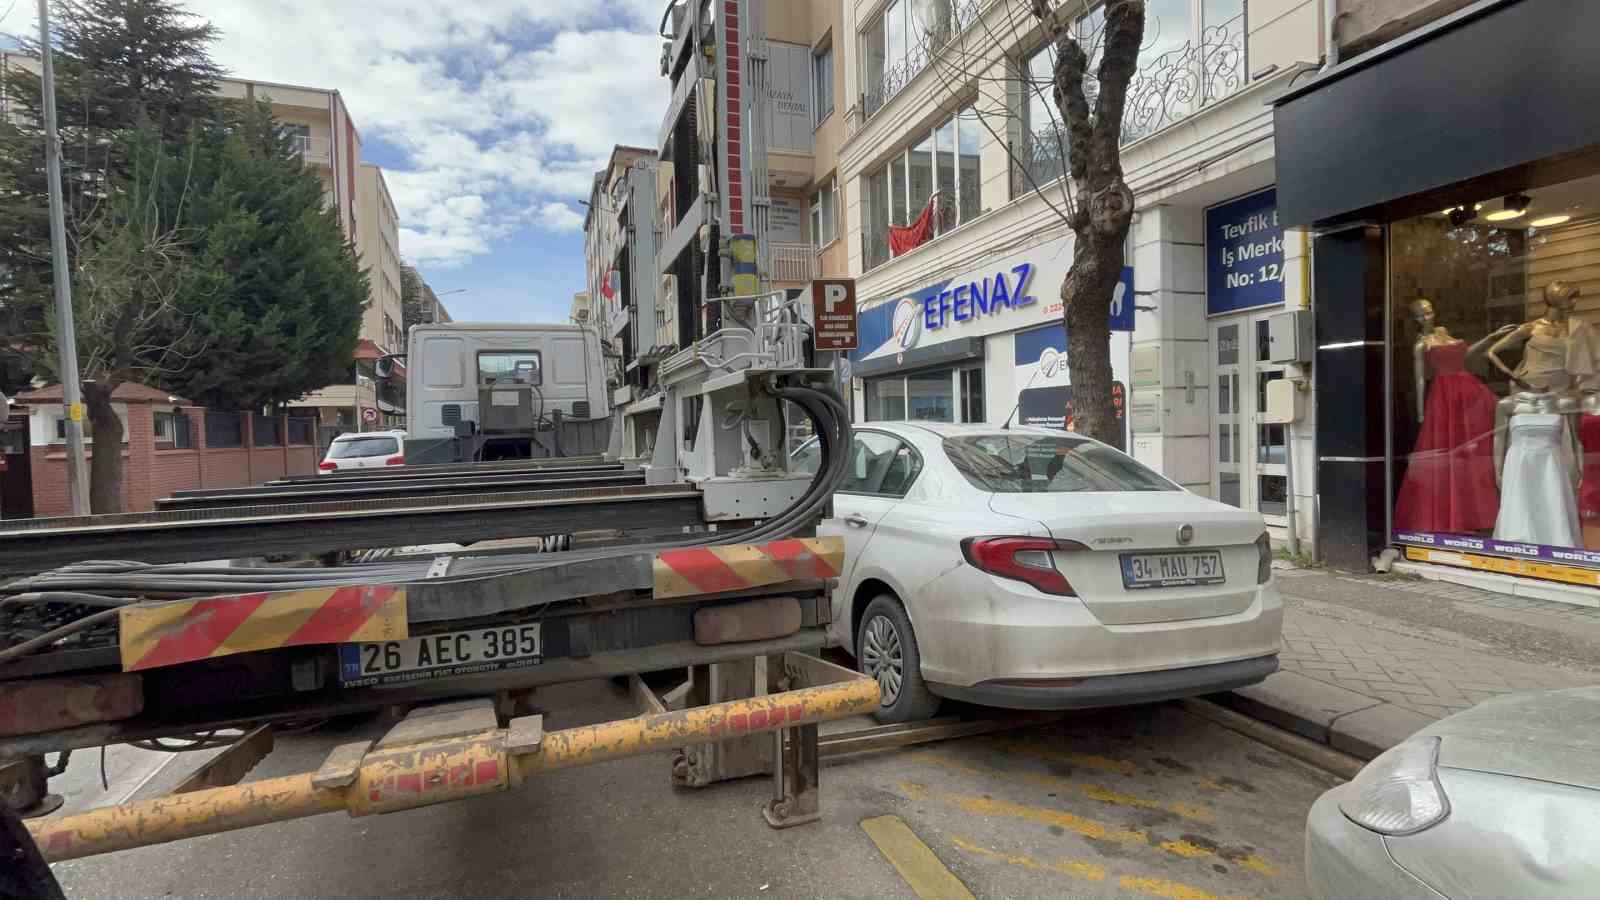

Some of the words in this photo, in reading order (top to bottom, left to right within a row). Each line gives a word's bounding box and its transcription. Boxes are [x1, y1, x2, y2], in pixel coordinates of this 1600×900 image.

[1220, 213, 1268, 240] Tevfik
[1227, 272, 1254, 288] No:
[824, 284, 847, 312] P
[924, 263, 1034, 330] EFENAZ
[1398, 533, 1435, 544] WORLD
[1443, 538, 1484, 550] WORLD
[1494, 543, 1538, 556] WORLD
[1552, 550, 1600, 563] WORLD
[1133, 557, 1153, 578] 34
[1159, 556, 1188, 578] MAU
[1193, 555, 1217, 575] 757
[364, 641, 401, 673] 26
[417, 633, 471, 667] AEC
[483, 626, 536, 659] 385
[344, 676, 378, 689] IVECO
